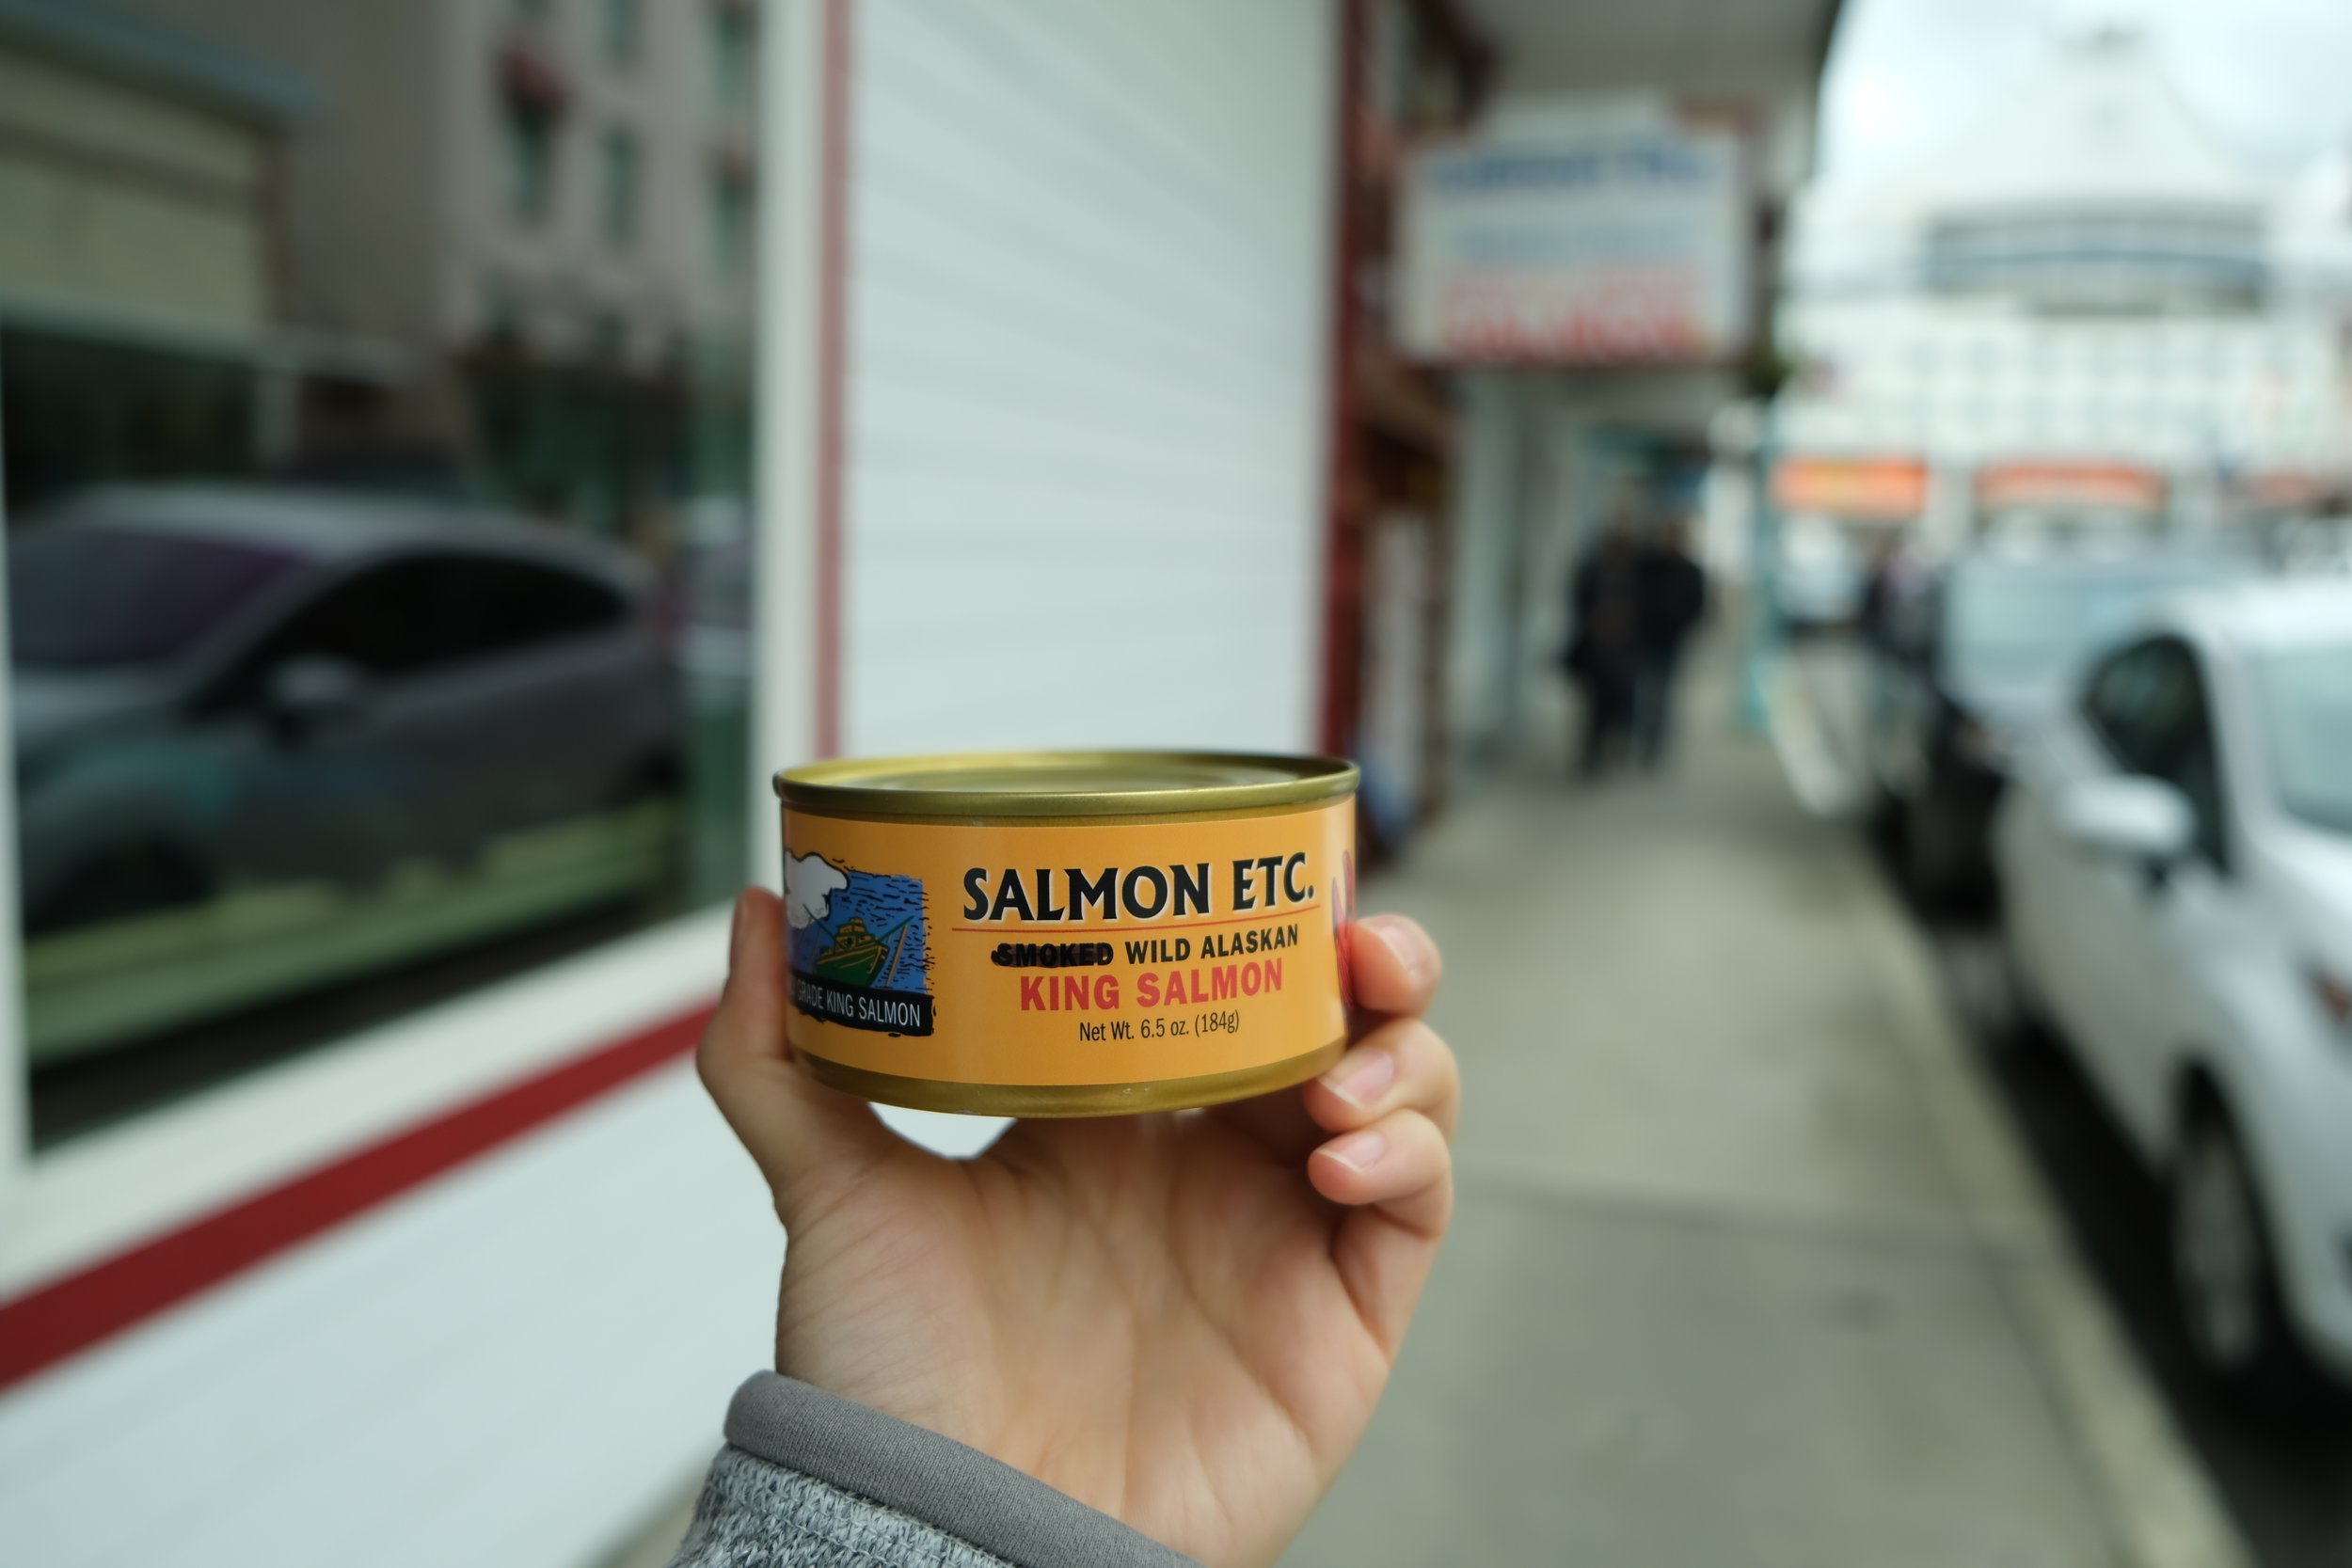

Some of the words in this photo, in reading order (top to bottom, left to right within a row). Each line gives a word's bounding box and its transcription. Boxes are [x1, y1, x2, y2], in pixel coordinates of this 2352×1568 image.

[963, 863, 1210, 922] SALMON
[1232, 852, 1314, 911] ETC.
[994, 942, 1113, 967] SMOKED
[1125, 938, 1191, 965] WILD
[1200, 924, 1298, 959] ALASKAN
[1021, 974, 1120, 1011] KING
[1136, 958, 1282, 1008] SALMON
[826, 990, 854, 1018] KING
[858, 996, 921, 1028] SALMON
[1079, 1022, 1106, 1042] Net
[1110, 1021, 1135, 1040] Wt.
[1140, 1019, 1166, 1039] 6.5
[1170, 1021, 1190, 1037] oz.
[1194, 1009, 1240, 1038] (184g)
